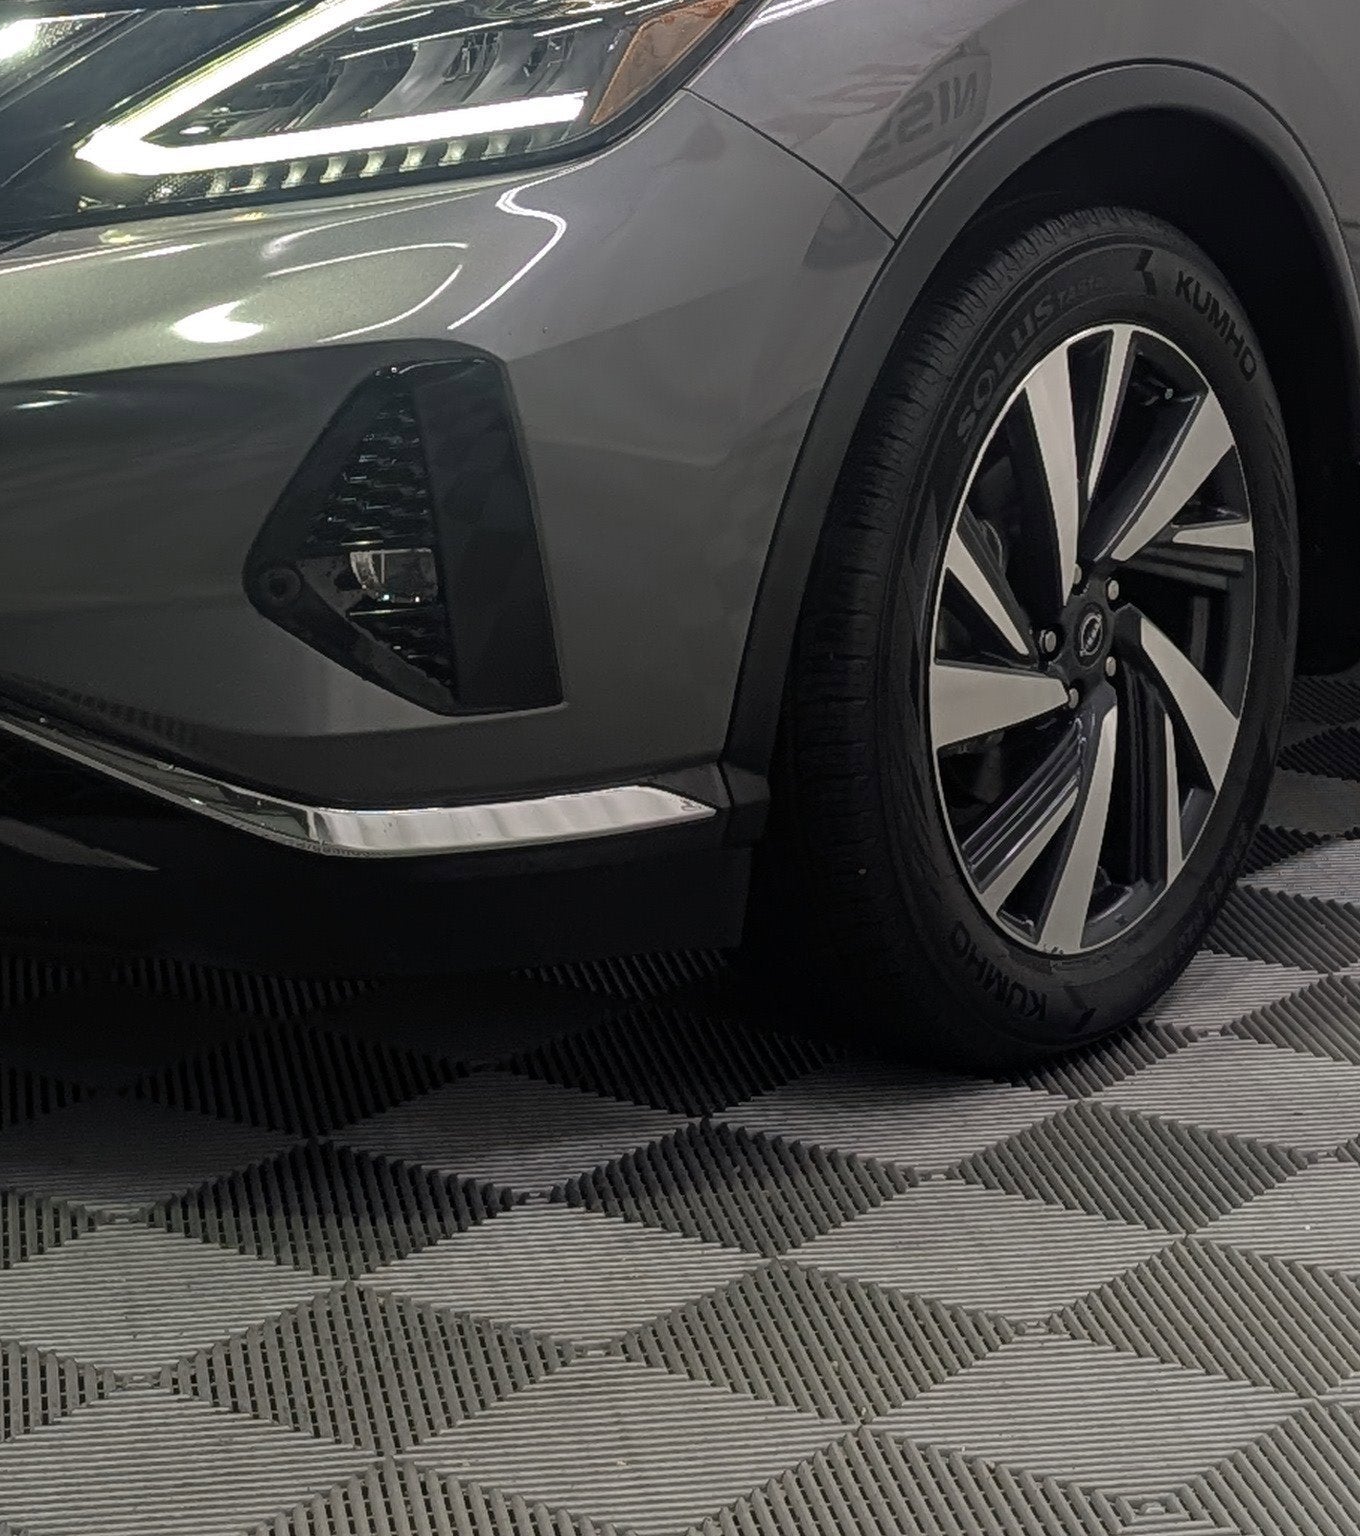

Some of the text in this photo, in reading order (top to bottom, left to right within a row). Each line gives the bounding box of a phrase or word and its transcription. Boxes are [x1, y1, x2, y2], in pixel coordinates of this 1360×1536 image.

[956, 294, 1055, 442] SOLUS
[1175, 270, 1258, 382] KUMHO
[950, 920, 1047, 1021] KUMHO
